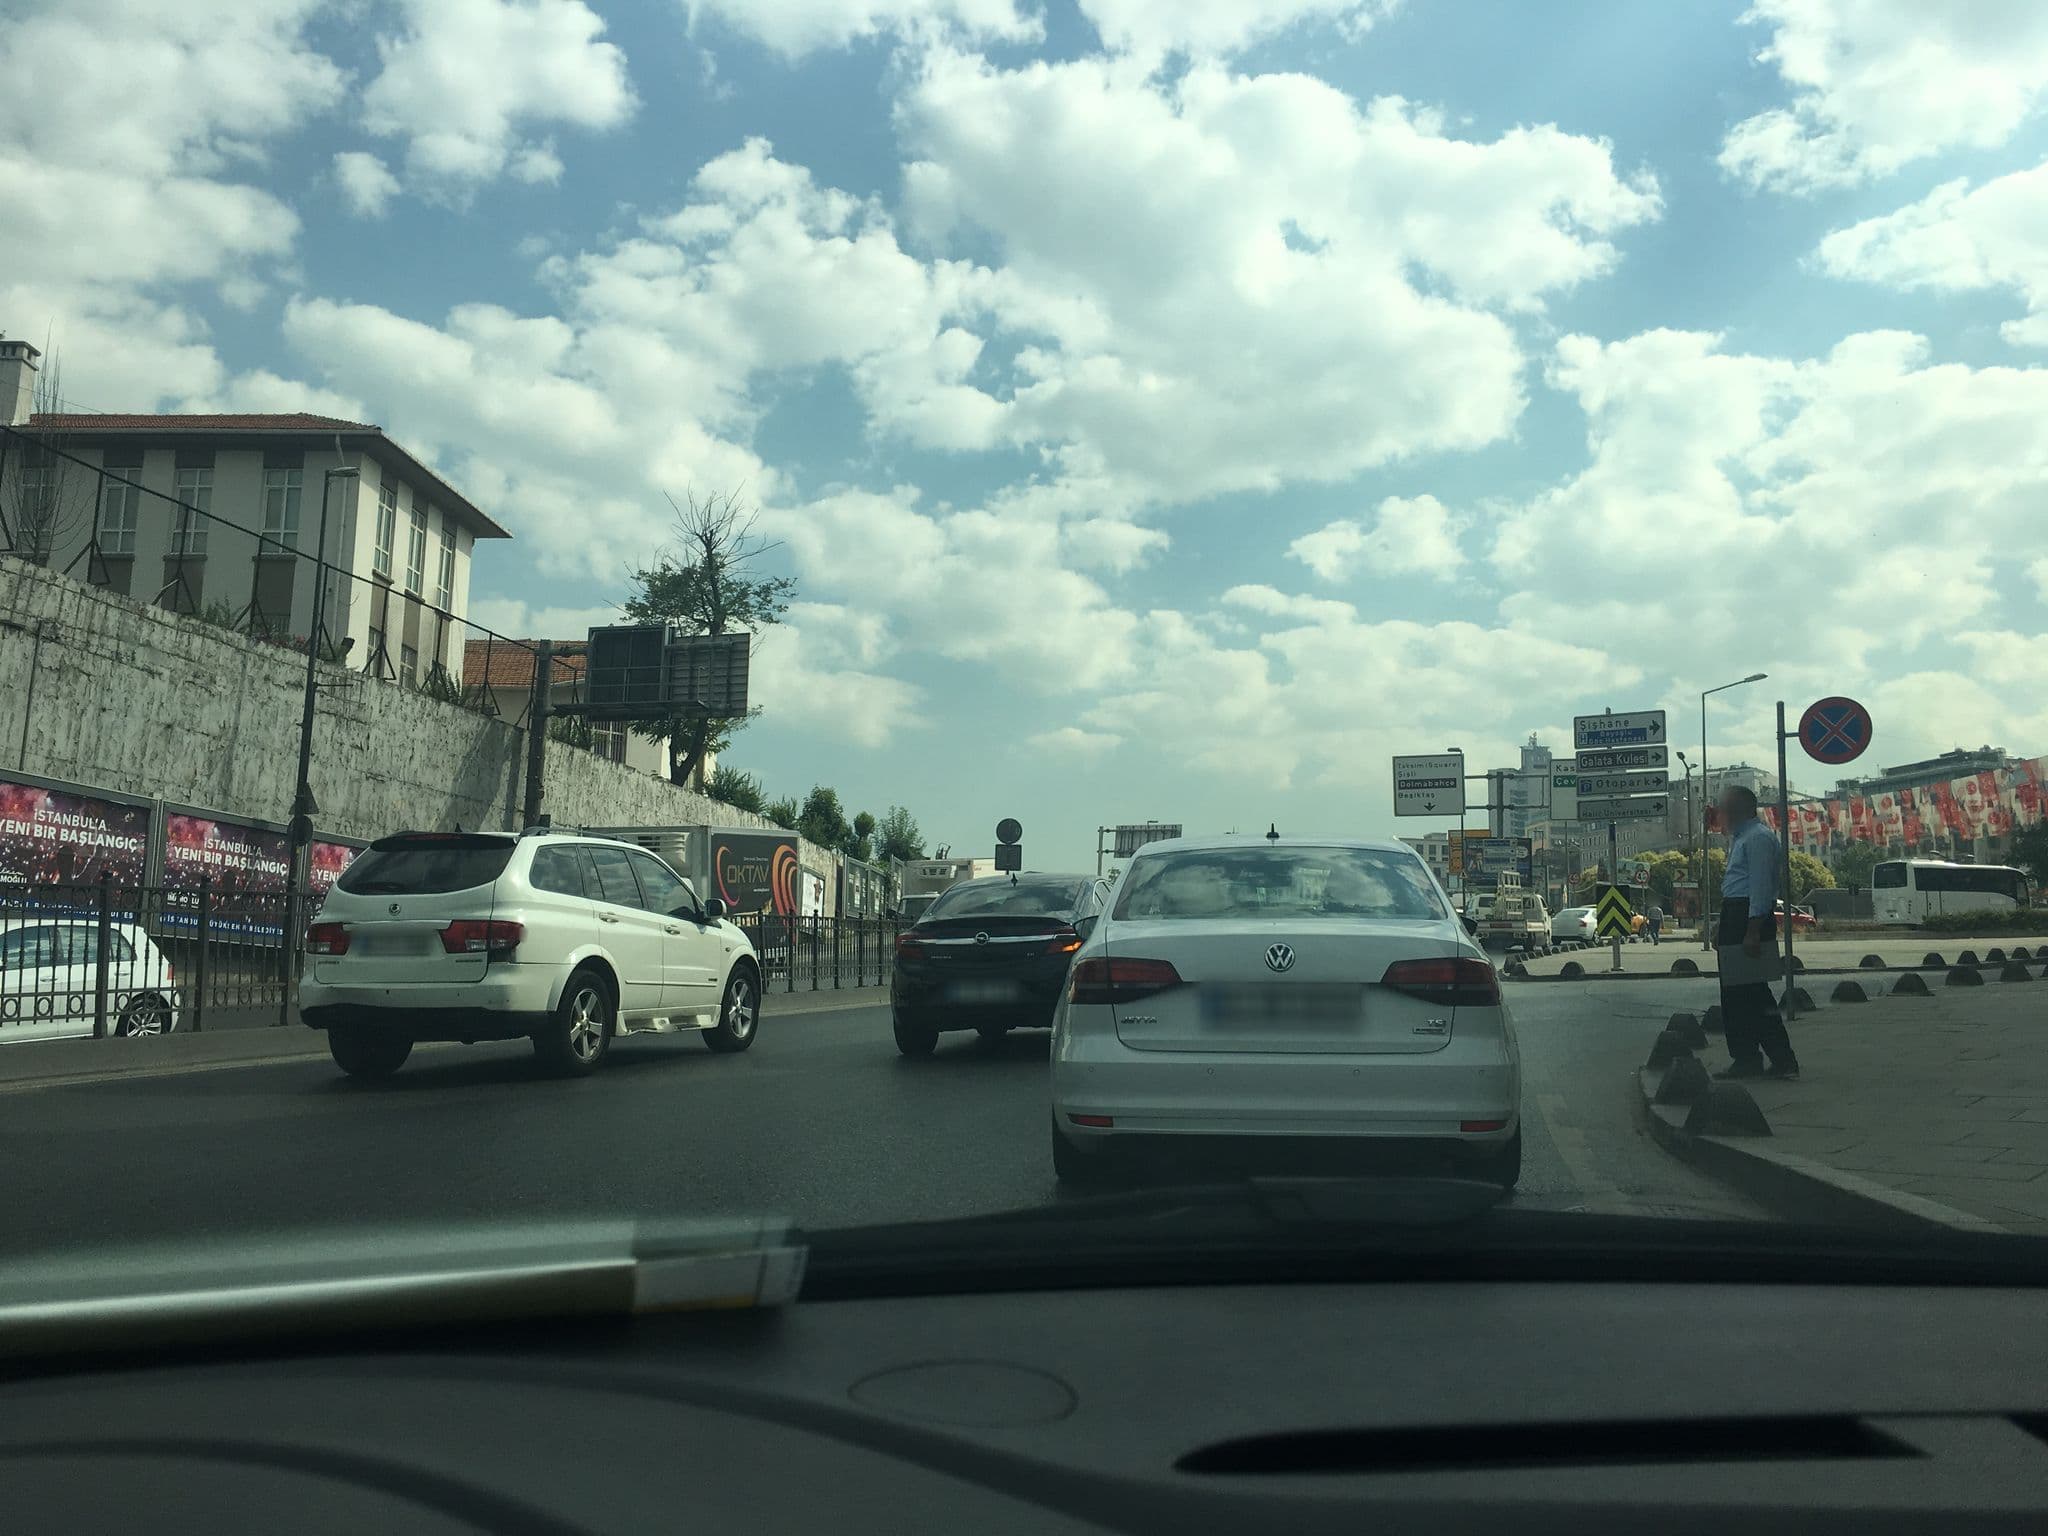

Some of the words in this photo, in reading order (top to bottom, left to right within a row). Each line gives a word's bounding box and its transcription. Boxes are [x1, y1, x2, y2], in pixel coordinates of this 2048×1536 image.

[1579, 719, 1630, 731] Şişhane
[1581, 756, 1613, 767] Galata
[1616, 753, 1647, 765] Kulesi
[1596, 777, 1650, 789] Otopark
[33, 823, 57, 840] BİR
[60, 828, 138, 853] BAŞLANGIÇ
[174, 846, 201, 860] YENİ
[205, 851, 222, 865] BİR
[225, 853, 288, 876] BAŞLANGIÇ
[727, 864, 769, 884] OKTAV
